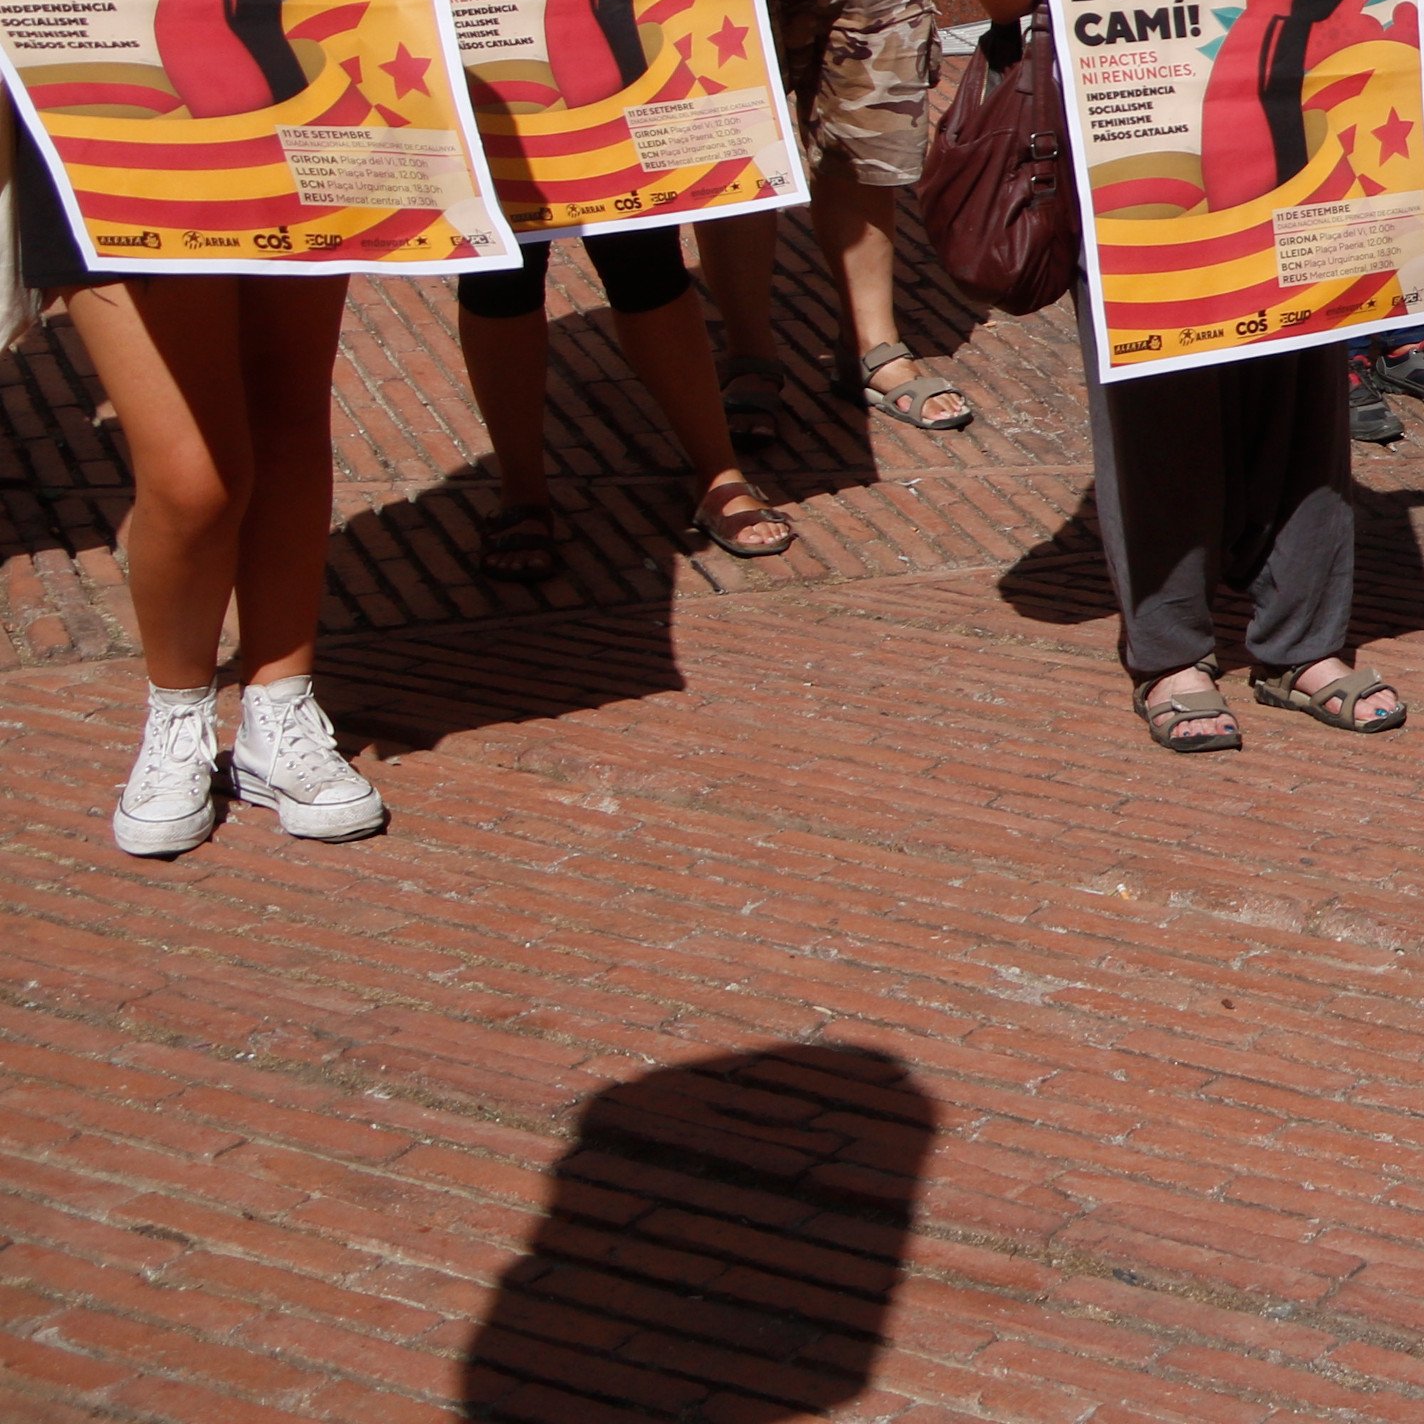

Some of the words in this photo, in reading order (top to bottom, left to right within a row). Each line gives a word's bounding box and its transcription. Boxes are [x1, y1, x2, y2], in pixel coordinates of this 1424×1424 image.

[1, 17, 89, 28] SOCIALISME
[8, 30, 89, 38] FEMINISME
[14, 39, 65, 49] PAÏSOS
[67, 40, 141, 49] CATALANS
[486, 36, 535, 50] CATALANS
[1079, 56, 1096, 70] NI
[1099, 51, 1158, 69] PACTES
[1081, 72, 1098, 86] NI
[1101, 61, 1196, 84] RENÚNCIES,
[1086, 84, 1176, 102] INDEPENDÈNCIA
[1088, 100, 1154, 116] SOCIALISME
[1091, 114, 1153, 129] FEMINISME
[1093, 128, 1132, 143] PAÏSOS
[1134, 124, 1189, 140] CATALANS
[1286, 211, 1299, 220] DE
[1300, 204, 1351, 218] SETEMBRE
[1279, 234, 1318, 247] GIRONA
[1279, 247, 1314, 259] LLEIDA
[1281, 261, 1302, 272] BCN
[1283, 273, 1308, 284] REUS
